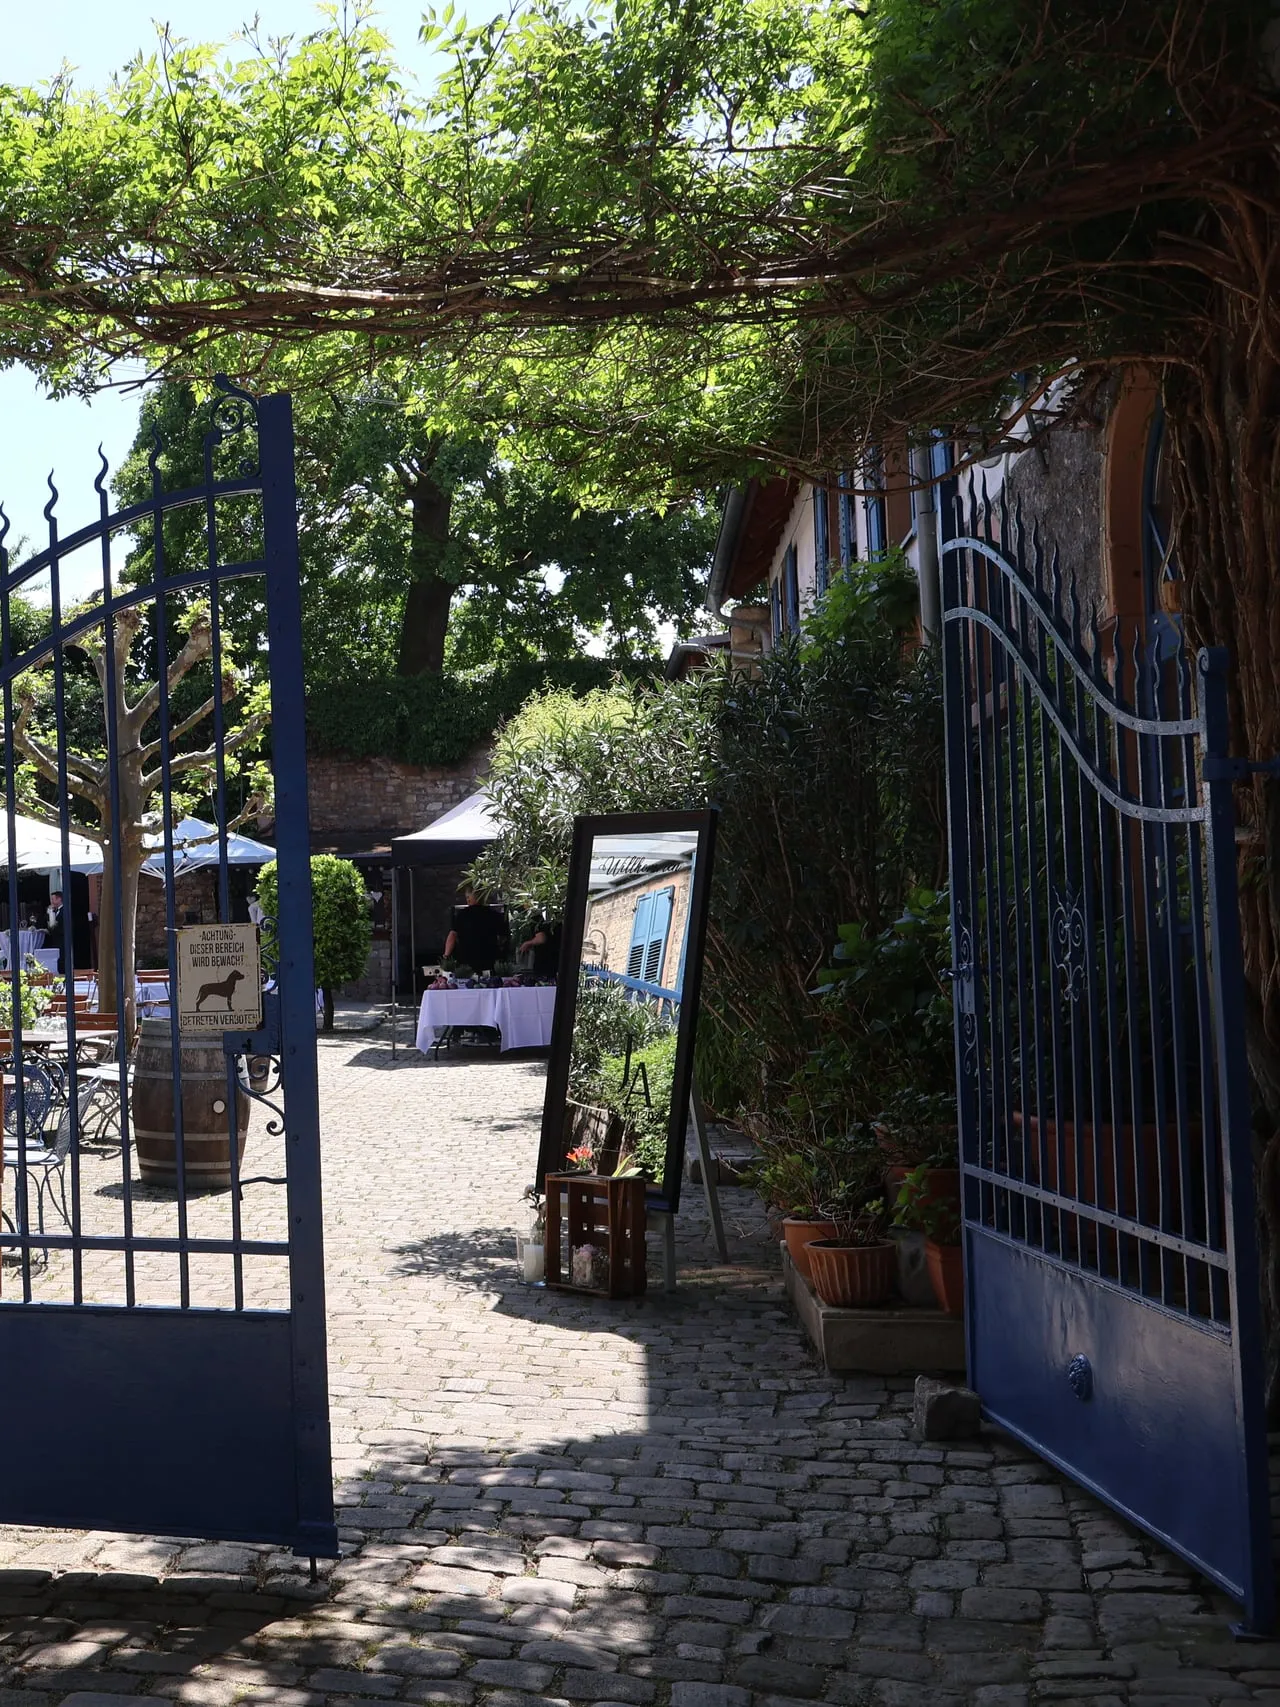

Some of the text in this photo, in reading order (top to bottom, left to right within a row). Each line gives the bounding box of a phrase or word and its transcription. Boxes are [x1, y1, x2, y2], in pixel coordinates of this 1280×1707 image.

[190, 943, 244, 955] DIESER BEREICH
[192, 956, 210, 967] WIRD
[183, 1014, 257, 1026] BETRETEN VERBOTEN
[623, 1062, 654, 1107] A
